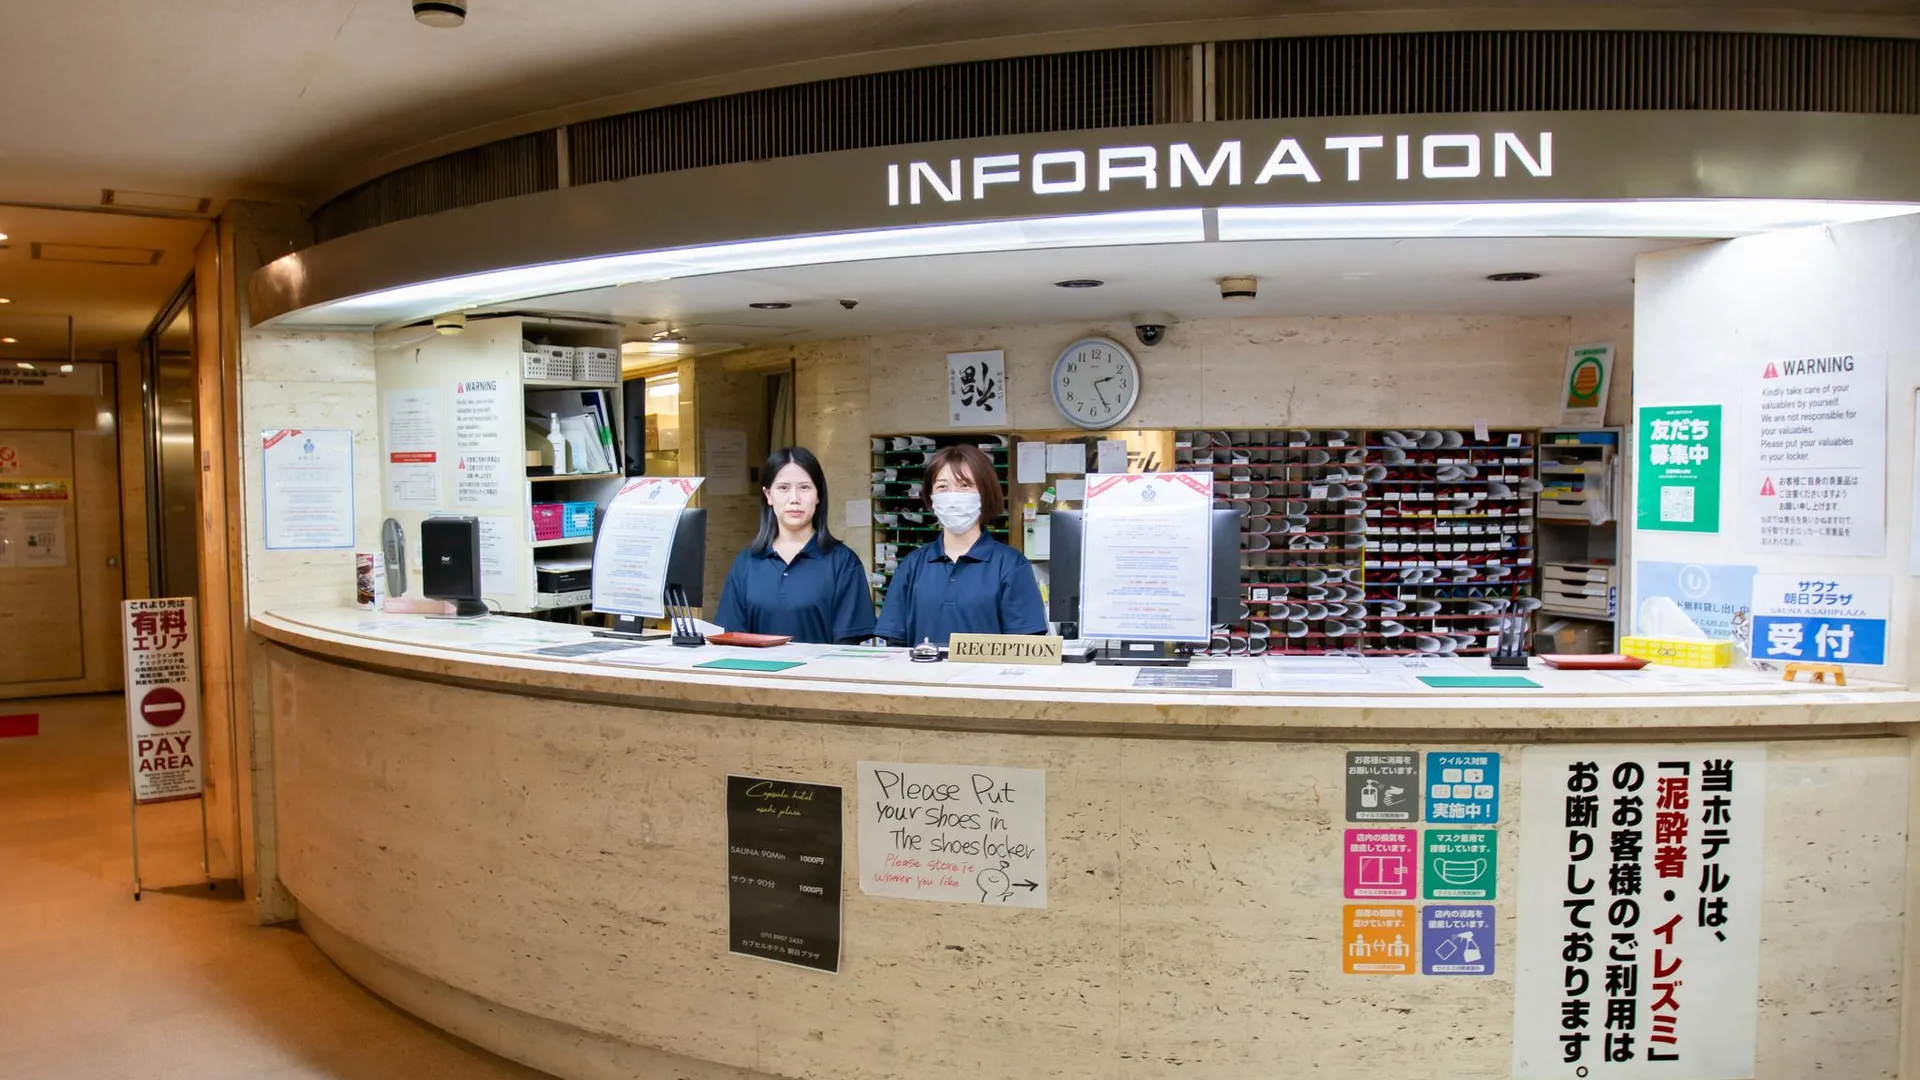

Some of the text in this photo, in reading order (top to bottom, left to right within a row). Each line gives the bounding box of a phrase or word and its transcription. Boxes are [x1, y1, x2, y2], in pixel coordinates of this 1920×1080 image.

[888, 131, 1552, 206] INFORMATION
[1078, 352, 1086, 363] 11
[1092, 349, 1102, 360] 12
[1108, 353, 1112, 364] 1
[1067, 363, 1077, 373] 10
[1115, 364, 1124, 375] 2
[1783, 355, 1854, 376] WARNING
[466, 380, 497, 392] WARNING
[1063, 376, 1070, 387] 9
[1119, 379, 1127, 389] 3
[1066, 391, 1074, 401] 8
[1762, 387, 1784, 397] Kindly
[1786, 386, 1801, 396] take
[1822, 384, 1831, 393] of
[1832, 385, 1849, 395] your
[1115, 394, 1121, 404] 4
[1761, 398, 1840, 410] valuables by yourself.
[1077, 401, 1084, 413] 7
[1089, 407, 1097, 417] 6
[1104, 402, 1111, 414] 5
[1761, 410, 1857, 423] We are not responsible for
[1650, 418, 1710, 441] 友だち
[1761, 425, 1814, 437] your valuables.
[1760, 437, 1854, 449] Please put your valuables
[1650, 443, 1709, 466] 募集中
[1760, 452, 1768, 461] in
[1769, 453, 1784, 463] your
[1797, 580, 1839, 593] サウナ
[130, 600, 185, 610] これより先は
[1783, 592, 1854, 606] 朝日プラザ
[1770, 607, 1867, 617] SAUNA ASAHIPLAZA
[131, 609, 187, 636] 有料
[132, 633, 188, 651] エリア
[1766, 622, 1855, 659] 受付
[956, 641, 1057, 658] RECEPTION
[138, 735, 192, 757] PAY
[139, 754, 194, 772] AREA
[1354, 756, 1412, 765] お客様に消毒を
[1439, 756, 1489, 766] ウイルス対策
[1348, 766, 1418, 775] お願いしています。
[746, 781, 813, 801] Capsule hotel
[874, 769, 1017, 805] Please Put
[876, 801, 923, 823] your
[988, 809, 1008, 832] in
[889, 827, 1035, 860] The shoes locker
[1436, 834, 1486, 842] マスク着用で
[730, 845, 825, 865] SAUNA 90Min 1000円
[1698, 759, 1734, 942] 当ホテルは、
[884, 853, 922, 869] Please
[927, 859, 959, 873] store
[731, 874, 824, 896] サウナ 90分 1000円
[917, 876, 933, 888] you
[939, 874, 960, 888] like
[1434, 909, 1484, 918] 店内の消毒を
[1604, 762, 1645, 1063] のお客様のご利用は
[1647, 761, 1691, 1061] 「泥酔者・イレズミ」
[1559, 761, 1600, 1078] お断りしております。
[742, 939, 820, 960] カプセルホテル 朝日プラザ
